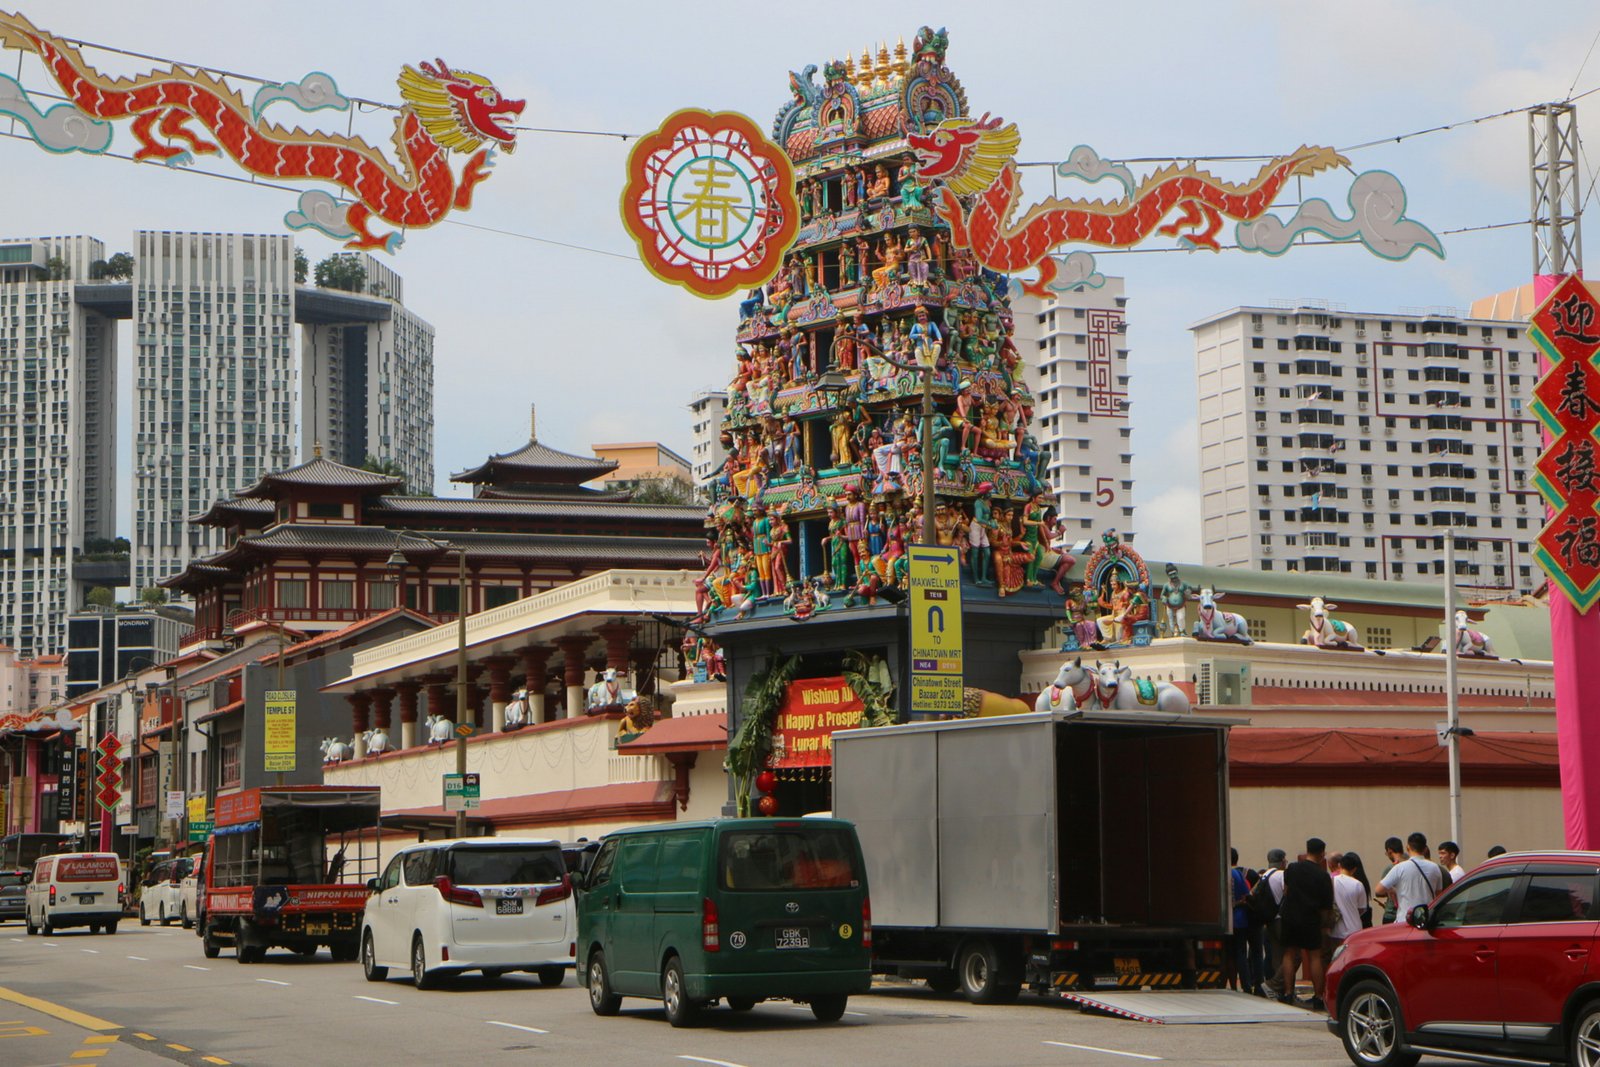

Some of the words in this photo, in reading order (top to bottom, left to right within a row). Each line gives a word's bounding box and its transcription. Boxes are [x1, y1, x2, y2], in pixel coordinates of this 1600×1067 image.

[674, 158, 749, 243] 春
[1548, 293, 1600, 570] 迎春接福
[1096, 477, 1114, 507] 5
[930, 564, 939, 574] TO
[911, 577, 944, 588] MAXWELL
[945, 578, 959, 588] MRT
[933, 635, 941, 645] TO
[912, 649, 948, 658] CHINATOWN
[949, 650, 961, 658] MRT
[912, 676, 943, 687] Chinatown
[944, 677, 962, 688] Street
[802, 688, 840, 705] Wishing
[842, 686, 854, 702] All
[919, 689, 939, 699] Bazaar
[940, 689, 955, 700] 2024
[266, 706, 287, 714] TEMPLE
[288, 706, 295, 714] ST
[777, 714, 783, 729] A
[786, 713, 816, 731] Happy
[818, 713, 824, 727] &
[826, 711, 863, 727] Prosper
[792, 736, 820, 752] Lunar
[822, 734, 833, 750] Ne
[306, 891, 342, 899] NIPPON
[343, 890, 369, 898] PAINT
[782, 929, 801, 938] GBK
[843, 925, 848, 934] 8
[733, 934, 744, 943] 70
[777, 938, 808, 947] 7239B
